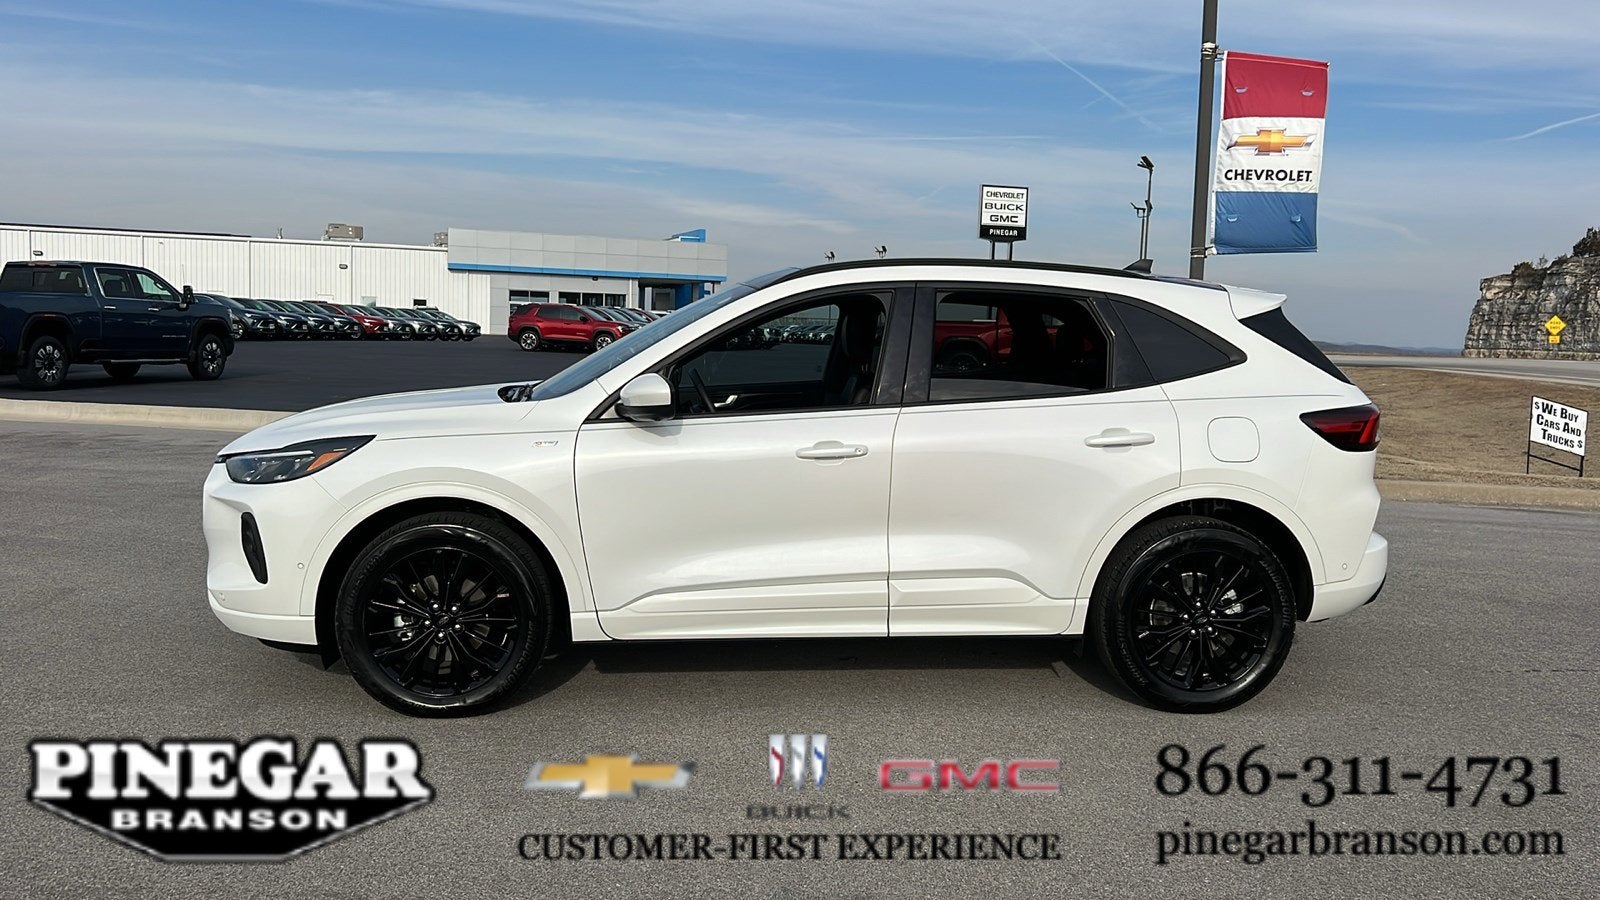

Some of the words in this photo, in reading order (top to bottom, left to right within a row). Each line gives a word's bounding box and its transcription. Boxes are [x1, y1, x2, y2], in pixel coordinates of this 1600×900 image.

[1224, 168, 1312, 182] CHEVROLET
[986, 191, 1024, 199] CHEVROLET
[984, 202, 1024, 211] BUICK
[989, 214, 1018, 223] GMC
[989, 228, 1017, 236] PINEGAR
